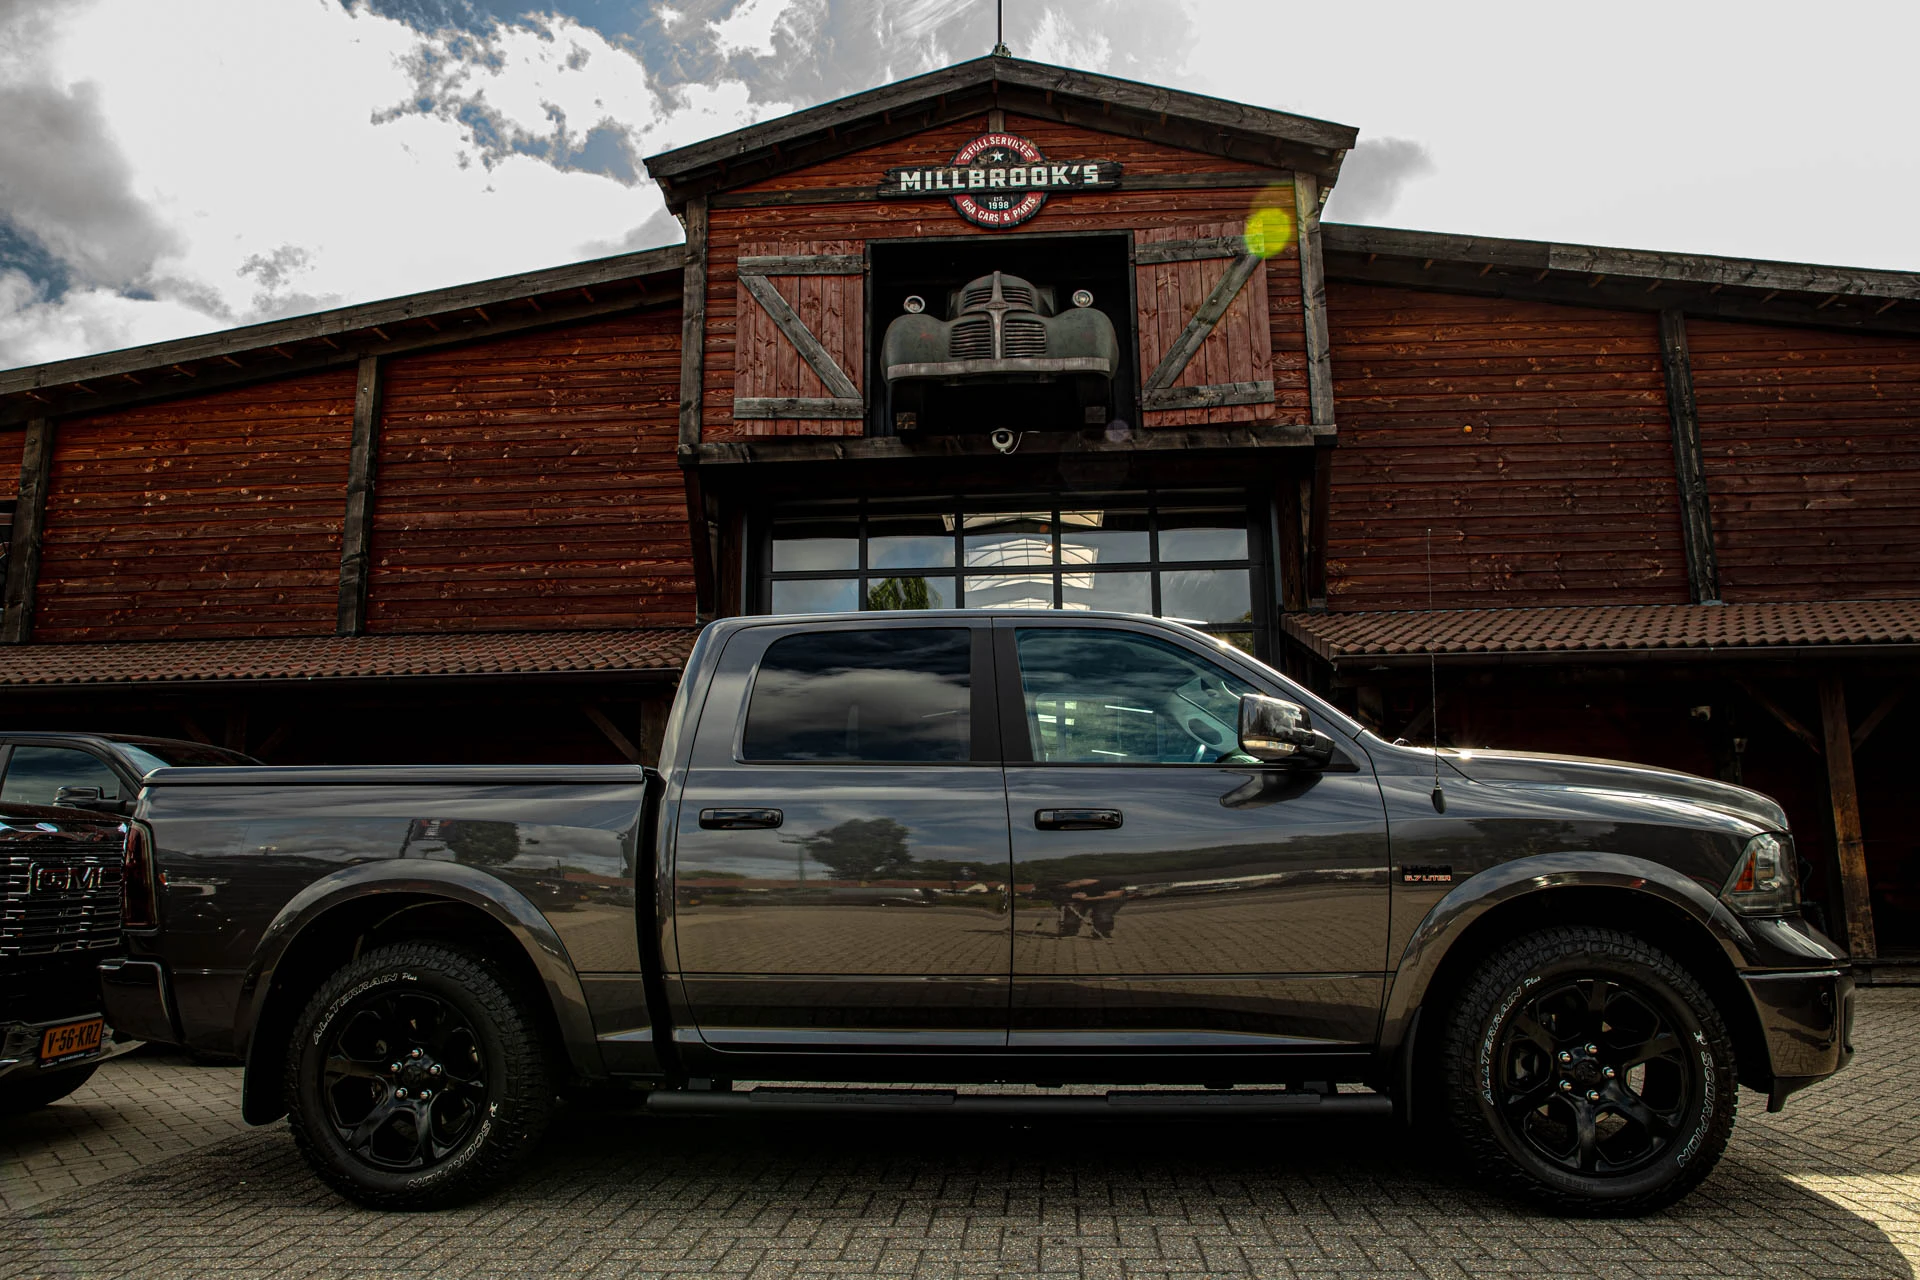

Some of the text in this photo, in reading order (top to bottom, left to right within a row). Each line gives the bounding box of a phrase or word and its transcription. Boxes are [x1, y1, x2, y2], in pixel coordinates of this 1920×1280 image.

[967, 136, 1028, 155] FULL SERVICE
[900, 164, 1099, 191] MILLBROOK'S
[961, 196, 1036, 222] USA CARS & PARTS
[988, 201, 1009, 210] 1998
[47, 1022, 101, 1054] V-56-KRZ
